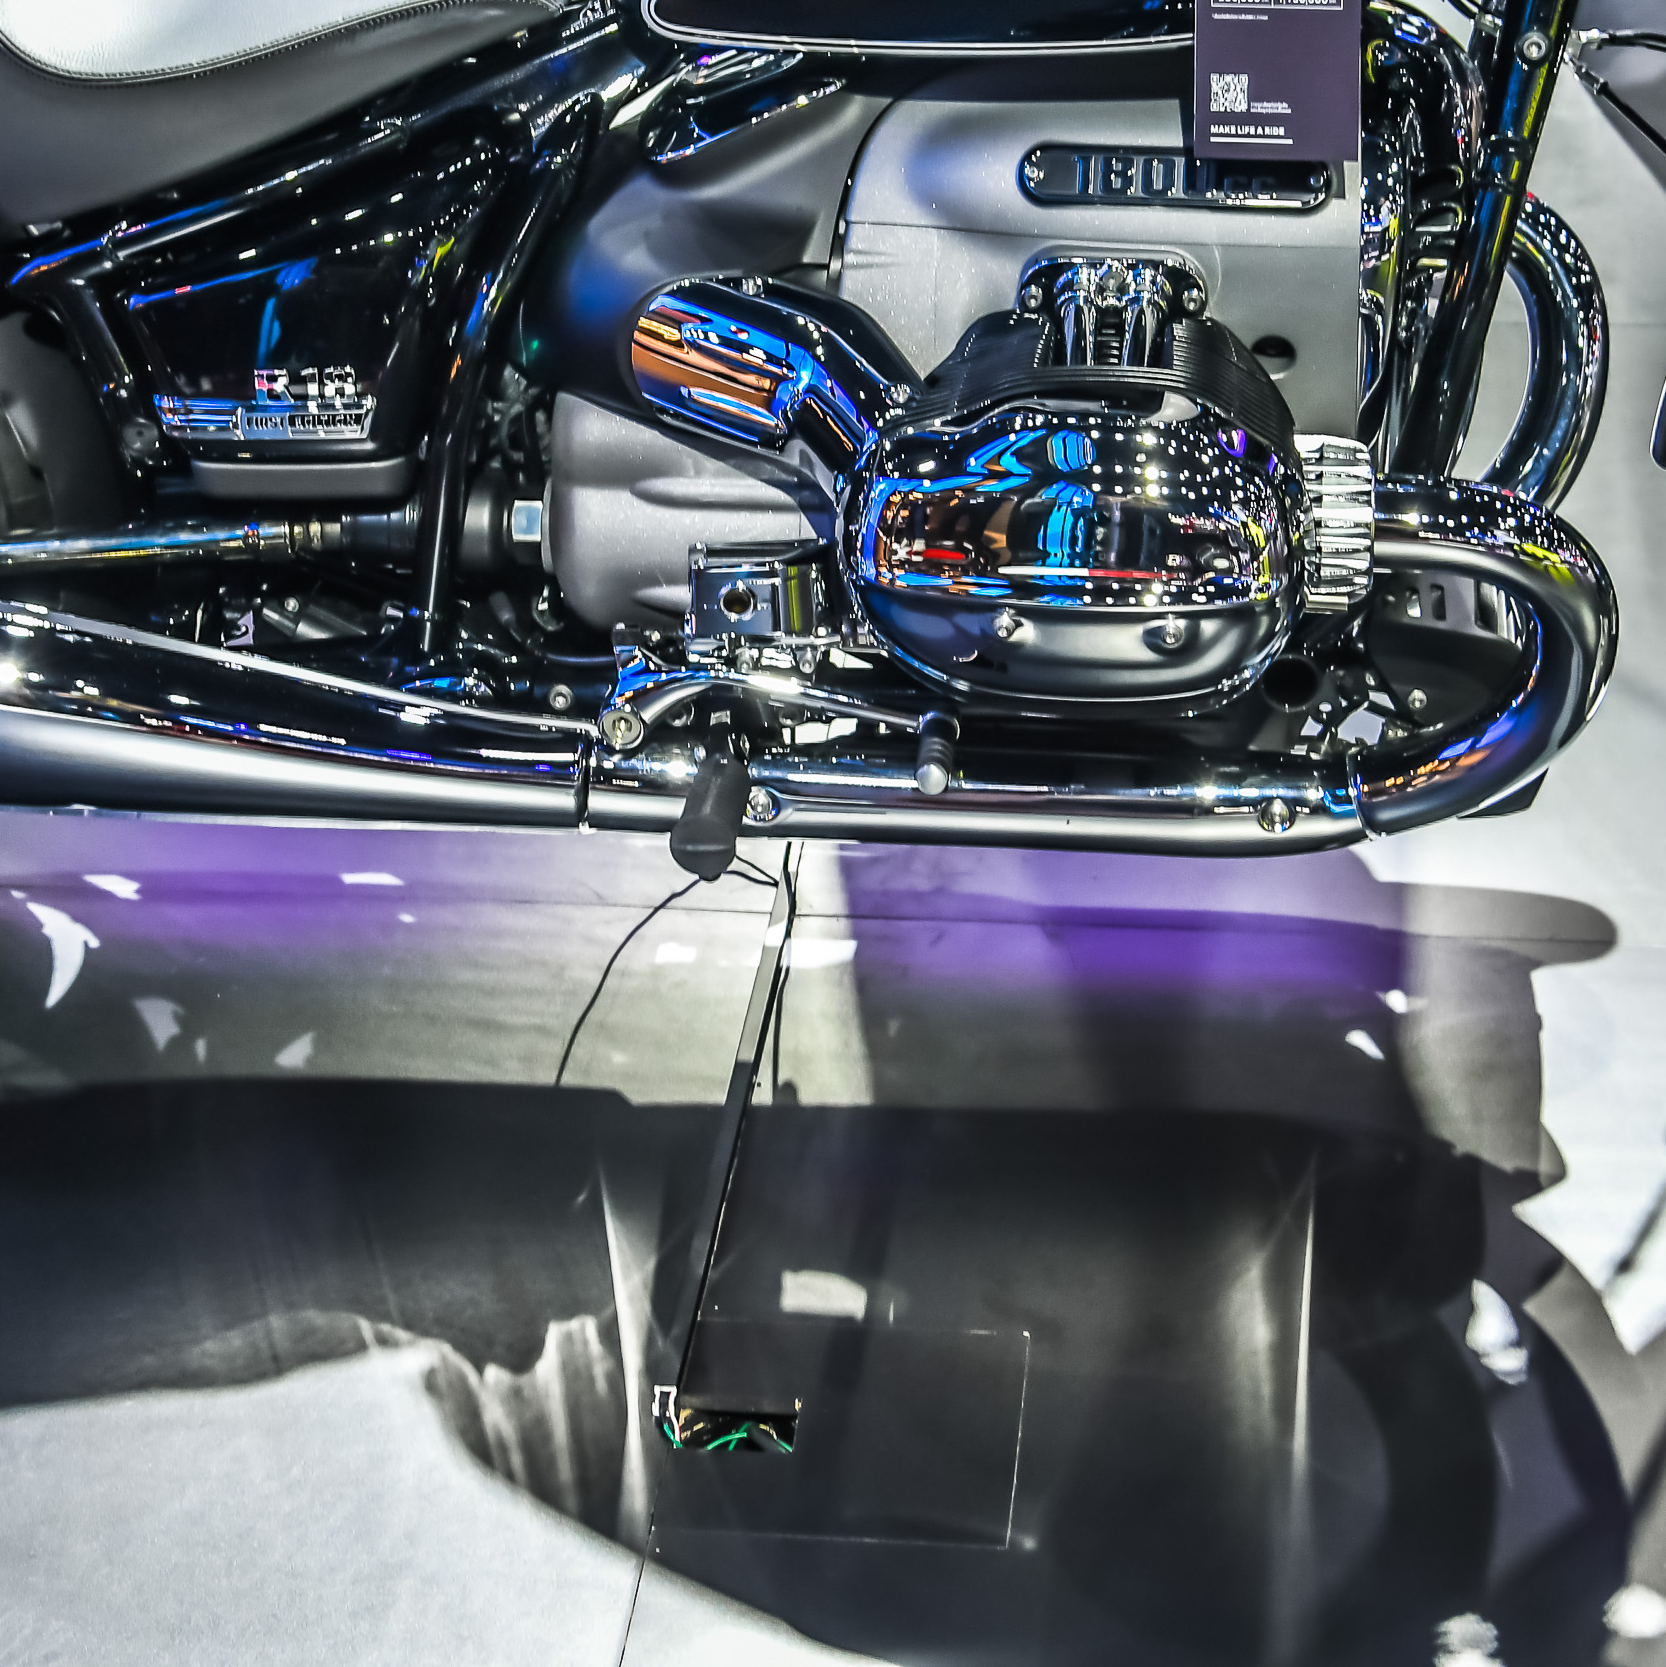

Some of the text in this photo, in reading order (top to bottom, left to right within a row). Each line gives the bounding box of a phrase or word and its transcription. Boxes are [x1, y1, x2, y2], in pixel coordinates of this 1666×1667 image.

[1210, 124, 1285, 136] MAKE LIFE A RIDE
[253, 365, 356, 404] R 18
[245, 414, 284, 431] FIRST
